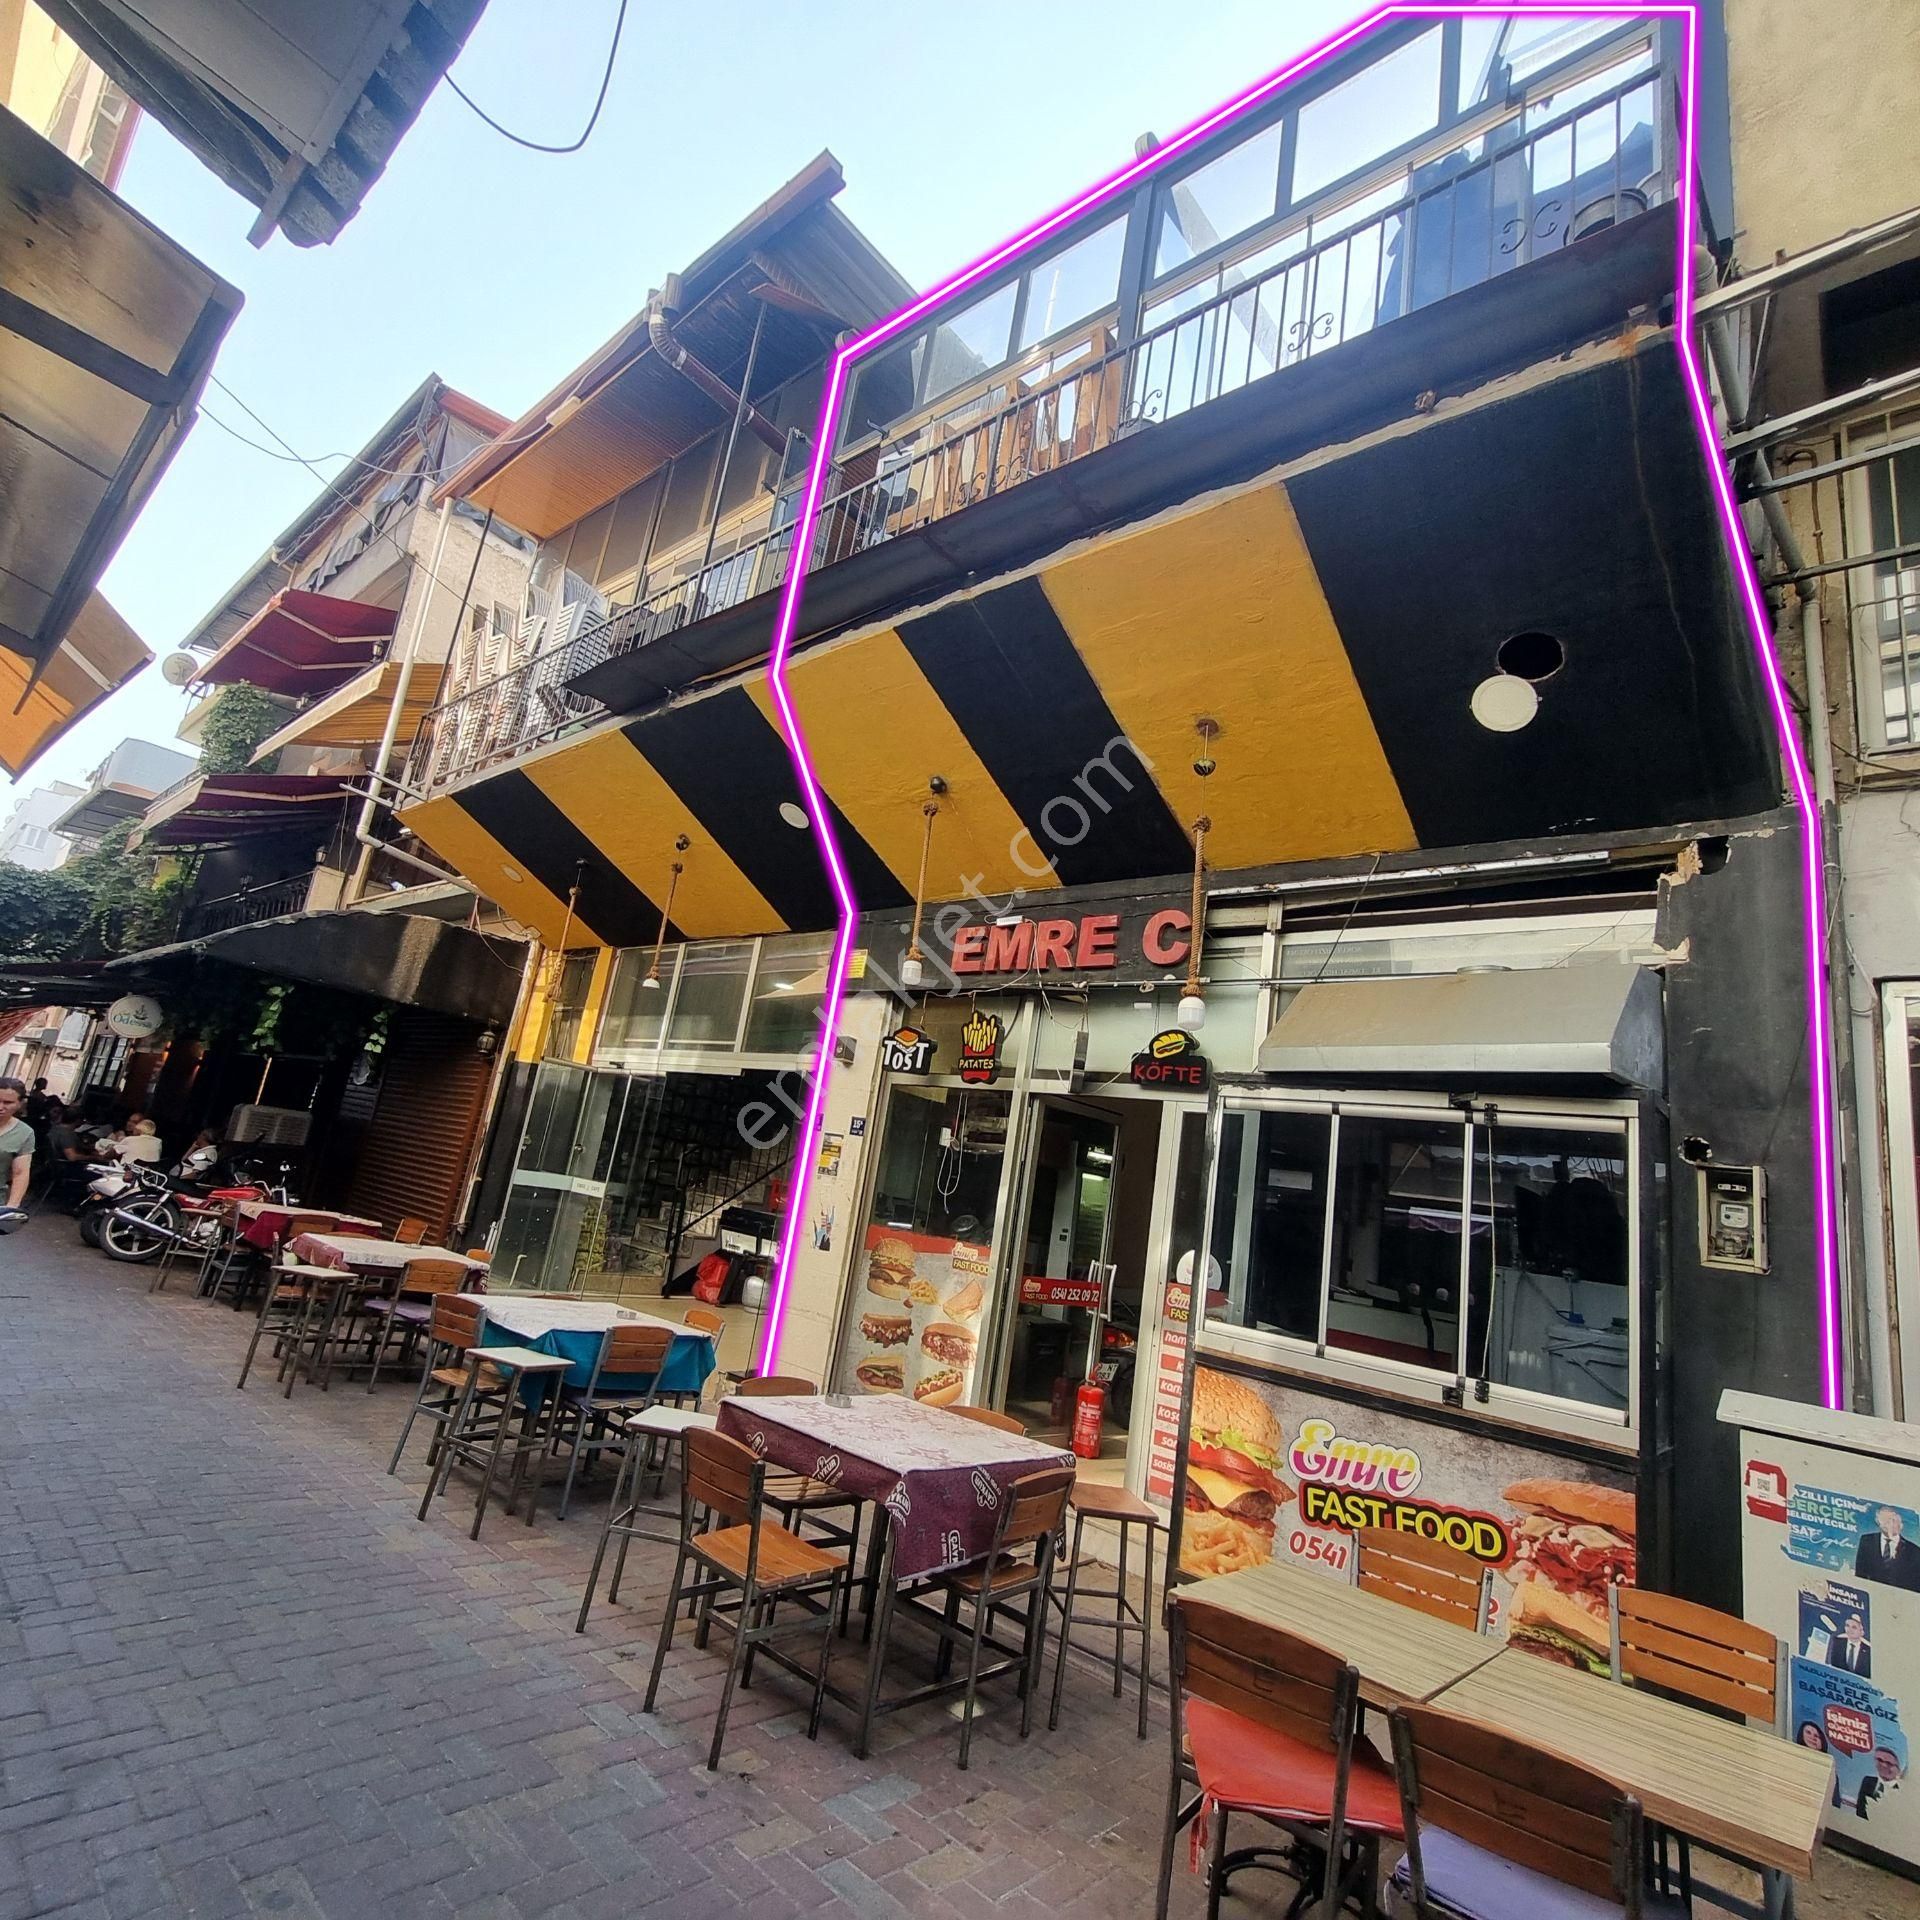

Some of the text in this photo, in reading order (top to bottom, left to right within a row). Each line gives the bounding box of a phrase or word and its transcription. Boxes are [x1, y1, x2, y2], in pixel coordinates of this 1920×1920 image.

[951, 914, 1120, 974] EMRE
[884, 1040, 929, 1071] TOST
[959, 1059, 994, 1069] PATATES
[1134, 1061, 1201, 1084] KÖFTE
[954, 1259, 989, 1274] FAST FOOD
[1051, 1287, 1067, 1300] 0541
[1067, 1288, 1080, 1300] 252
[1081, 1290, 1090, 1301] 09
[1291, 1420, 1420, 1495] Emre
[1307, 1486, 1501, 1557] FAST FOOD
[1289, 1531, 1348, 1569] 0541
[1825, 1681, 1841, 1693] EL
[1844, 1687, 1869, 1703] ELE
